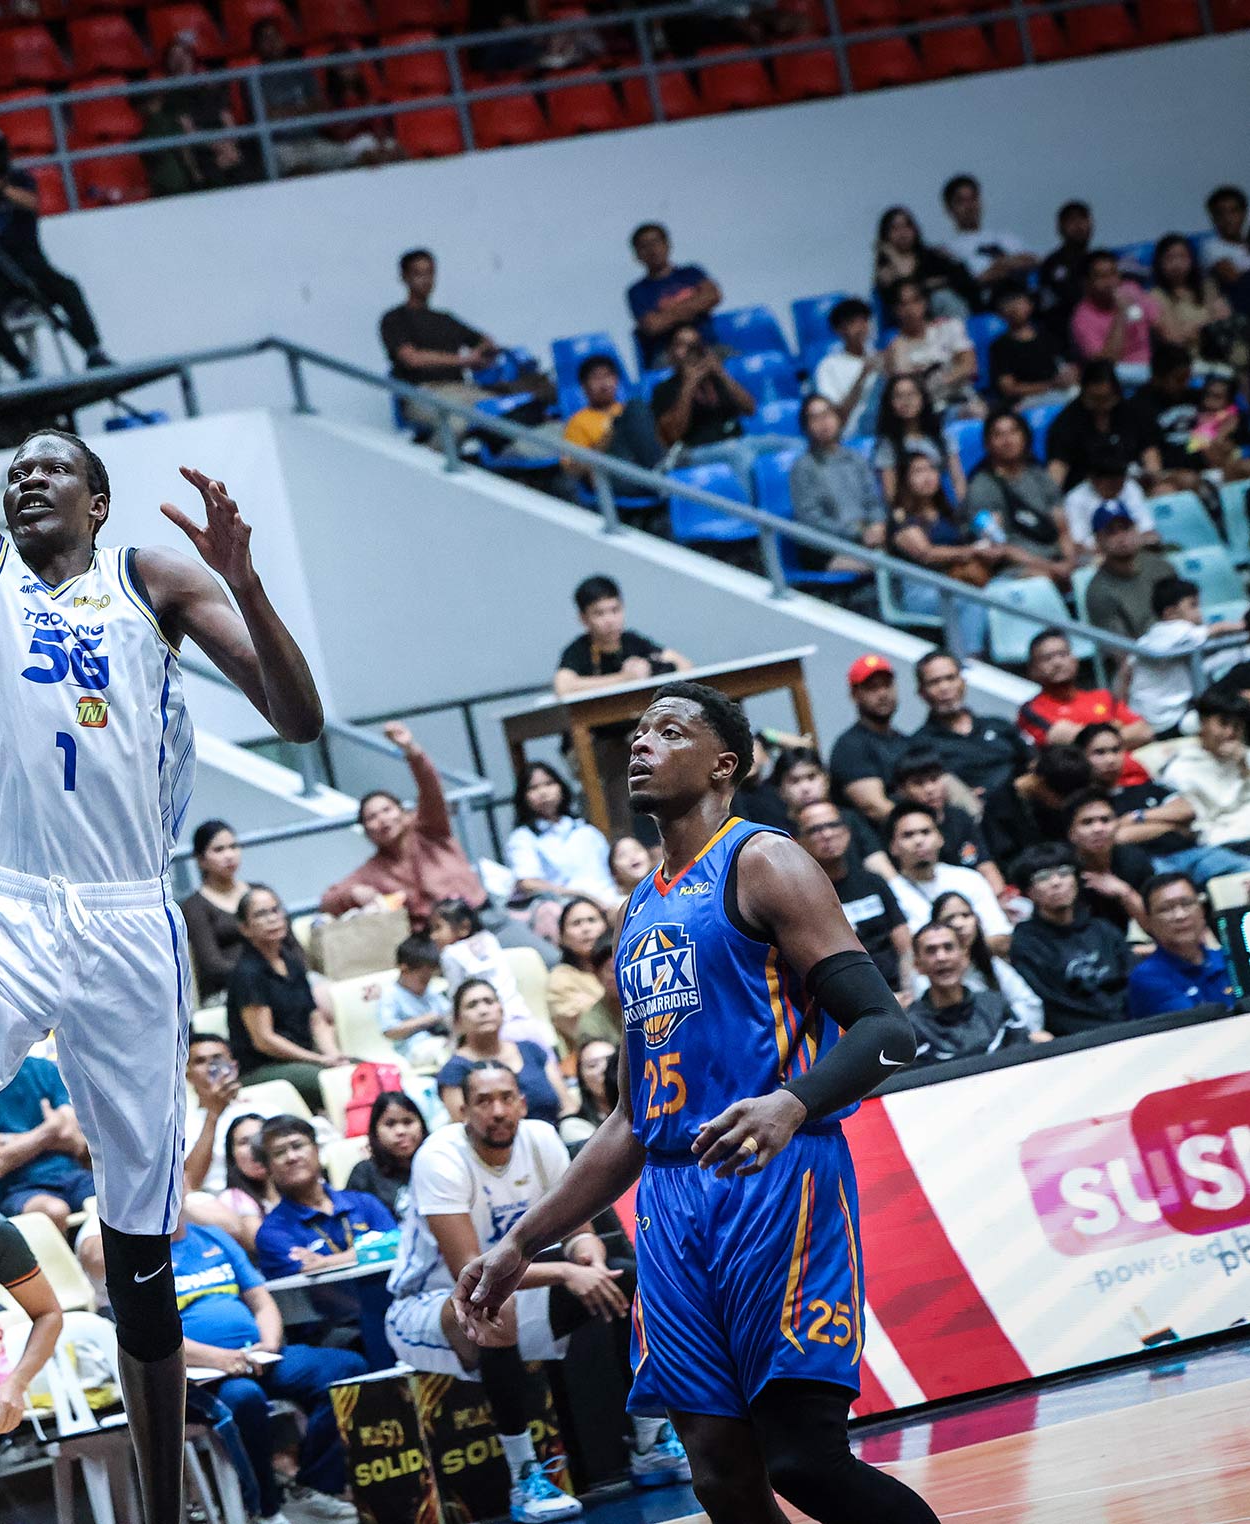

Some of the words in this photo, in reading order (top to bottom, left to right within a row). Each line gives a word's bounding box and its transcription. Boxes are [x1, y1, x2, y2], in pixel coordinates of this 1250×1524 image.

[23, 607, 105, 637] TRONG
[20, 627, 110, 691] 5G
[76, 701, 110, 724] TNT
[55, 731, 77, 792] 1
[644, 1052, 688, 1120] 25
[807, 1298, 852, 1347] 25
[355, 1448, 424, 1487] SOLID
